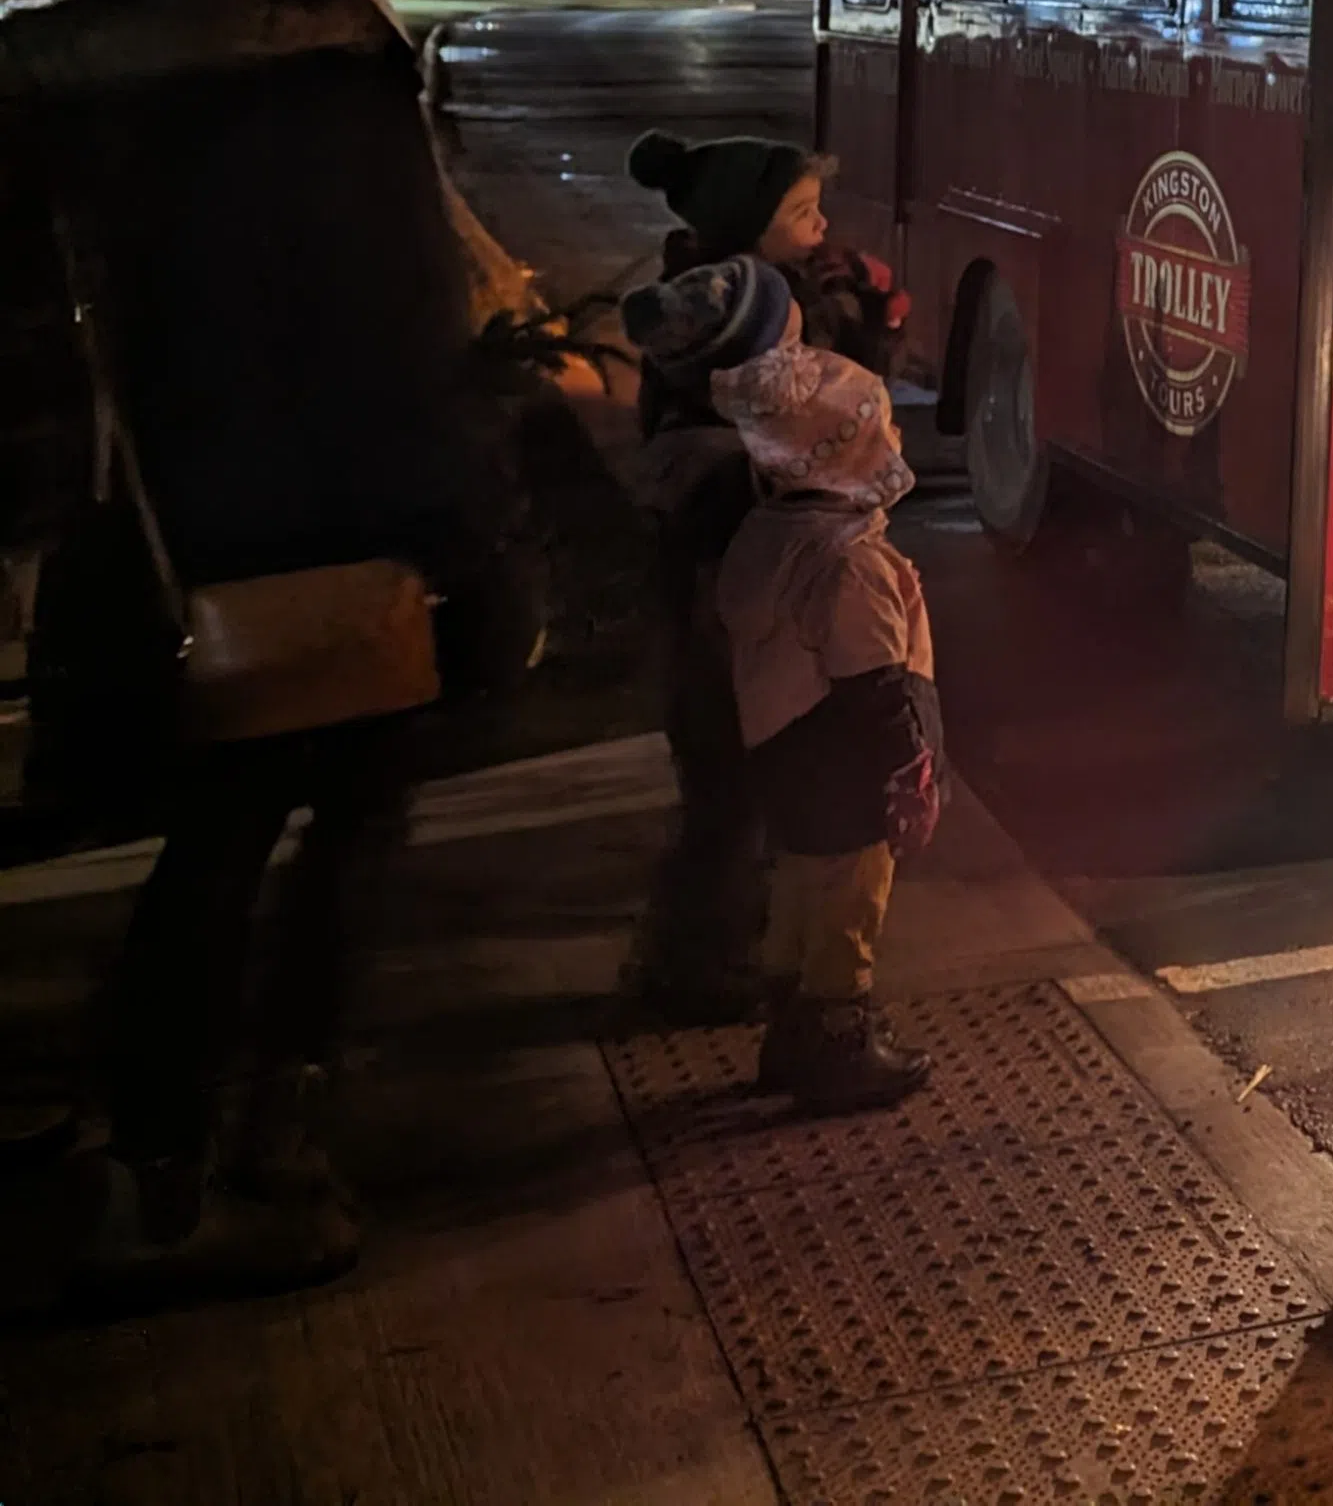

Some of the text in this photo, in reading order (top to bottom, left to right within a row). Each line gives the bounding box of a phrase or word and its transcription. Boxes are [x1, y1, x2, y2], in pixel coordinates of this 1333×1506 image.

[1142, 169, 1222, 235] KINGSTON
[1130, 250, 1232, 335] TROLLEY
[1150, 370, 1206, 417] TOURS
